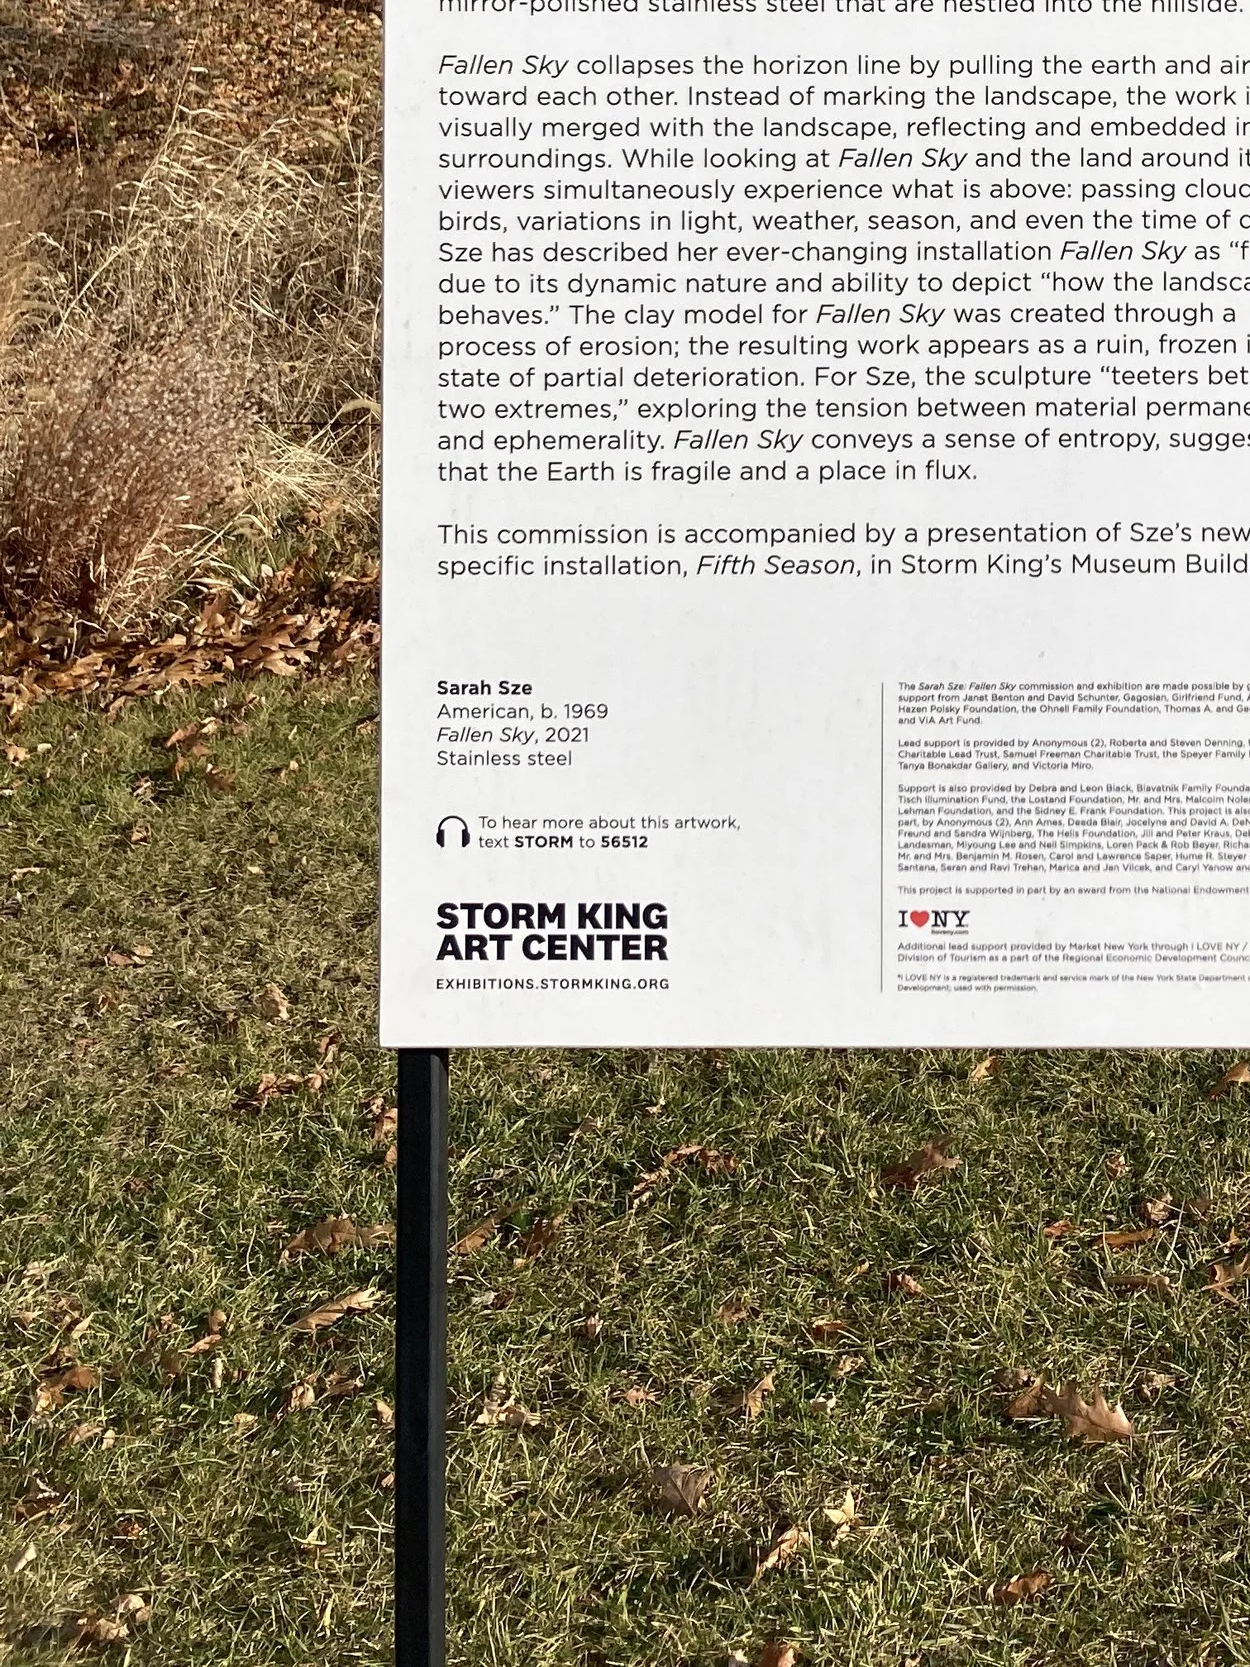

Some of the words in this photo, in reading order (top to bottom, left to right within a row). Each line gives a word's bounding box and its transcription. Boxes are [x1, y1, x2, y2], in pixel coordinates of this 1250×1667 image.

[438, 53, 514, 75] Fallen
[521, 54, 570, 79] Sky
[576, 53, 695, 79] collapses
[702, 53, 744, 75] the
[753, 54, 848, 75] horizon
[857, 54, 901, 75] line
[910, 54, 941, 79] by
[949, 53, 1033, 79] pulling
[1041, 54, 1083, 75] the
[1091, 54, 1156, 75] earth
[1164, 54, 1211, 75] and
[438, 85, 528, 107] toward
[536, 85, 597, 107] each
[606, 85, 678, 107] other.
[688, 85, 780, 107] Instead
[788, 85, 816, 106] of
[823, 85, 926, 110] marking
[934, 84, 976, 106] the
[984, 85, 1117, 110] landscape,
[1125, 84, 1167, 106] the
[1174, 84, 1237, 106] work
[438, 116, 534, 142] visually
[542, 116, 640, 142] merged
[649, 116, 704, 138] with
[712, 116, 755, 137] the
[763, 116, 897, 141] landscape,
[906, 116, 1026, 141] reflecting
[1034, 115, 1081, 137] and
[1090, 115, 1226, 137] embedded
[436, 523, 489, 545] This
[496, 523, 648, 545] commission
[657, 523, 676, 544] is
[684, 522, 856, 548] accompanied
[865, 521, 897, 548] by
[904, 527, 918, 543] a
[927, 521, 1087, 548] presentation
[1095, 521, 1122, 543] of
[1129, 521, 1192, 543] Sze’s
[437, 554, 535, 580] specific
[543, 554, 688, 579] installation,
[696, 553, 756, 576] Fifth
[763, 554, 862, 578] Season,
[871, 553, 892, 575] in
[901, 553, 978, 575] Storm
[987, 553, 1062, 578] King’s
[1071, 553, 1176, 575] Museum
[436, 679, 492, 696] Sarah
[497, 679, 533, 696] Sze
[897, 681, 917, 692] The
[917, 681, 945, 692] Sarah
[968, 681, 997, 691] Fallen
[998, 681, 1017, 693] Sky
[1018, 681, 1075, 692] commission
[1076, 681, 1095, 691] and
[1096, 681, 1143, 691] exhibition
[1144, 682, 1161, 691] are
[1162, 681, 1189, 691] made
[1191, 681, 1231, 692] possible
[1231, 680, 1245, 693] by
[436, 702, 534, 722] American,
[540, 702, 558, 720] b.
[563, 703, 609, 720] 1969
[897, 715, 916, 726] and
[937, 715, 954, 725] Art
[955, 715, 983, 725] Fund.
[436, 726, 494, 743] Fallen
[499, 725, 539, 746] Sky,
[544, 726, 589, 743] 2021
[436, 749, 521, 767] Stainless
[527, 749, 572, 767] steel
[477, 815, 497, 829] To
[502, 815, 538, 830] hear
[542, 818, 584, 830] more
[588, 815, 636, 830] about
[640, 814, 670, 830] this
[674, 815, 741, 831] artwork,
[478, 835, 510, 849] text
[514, 835, 574, 849] STORM
[578, 835, 596, 849] to
[600, 834, 649, 849] 56512
[897, 885, 917, 895] This
[918, 885, 953, 897] project
[954, 885, 963, 895] is
[964, 885, 1014, 896] supported
[1015, 885, 1025, 895] in
[1026, 885, 1047, 897] part
[1048, 885, 1062, 897] by
[1063, 886, 1076, 895] an
[1077, 885, 1107, 895] award
[1108, 885, 1132, 895] from
[1133, 885, 1150, 895] the
[1151, 885, 1191, 895] National
[1193, 884, 1250, 896] Endowment
[436, 902, 566, 930] STORM
[577, 902, 668, 930] KING
[898, 909, 908, 928] I
[931, 909, 970, 928] NY
[435, 933, 514, 961] ART
[521, 933, 669, 961] CENTER
[436, 978, 670, 990] EXHIBITIONS.STORMKING.ORG
